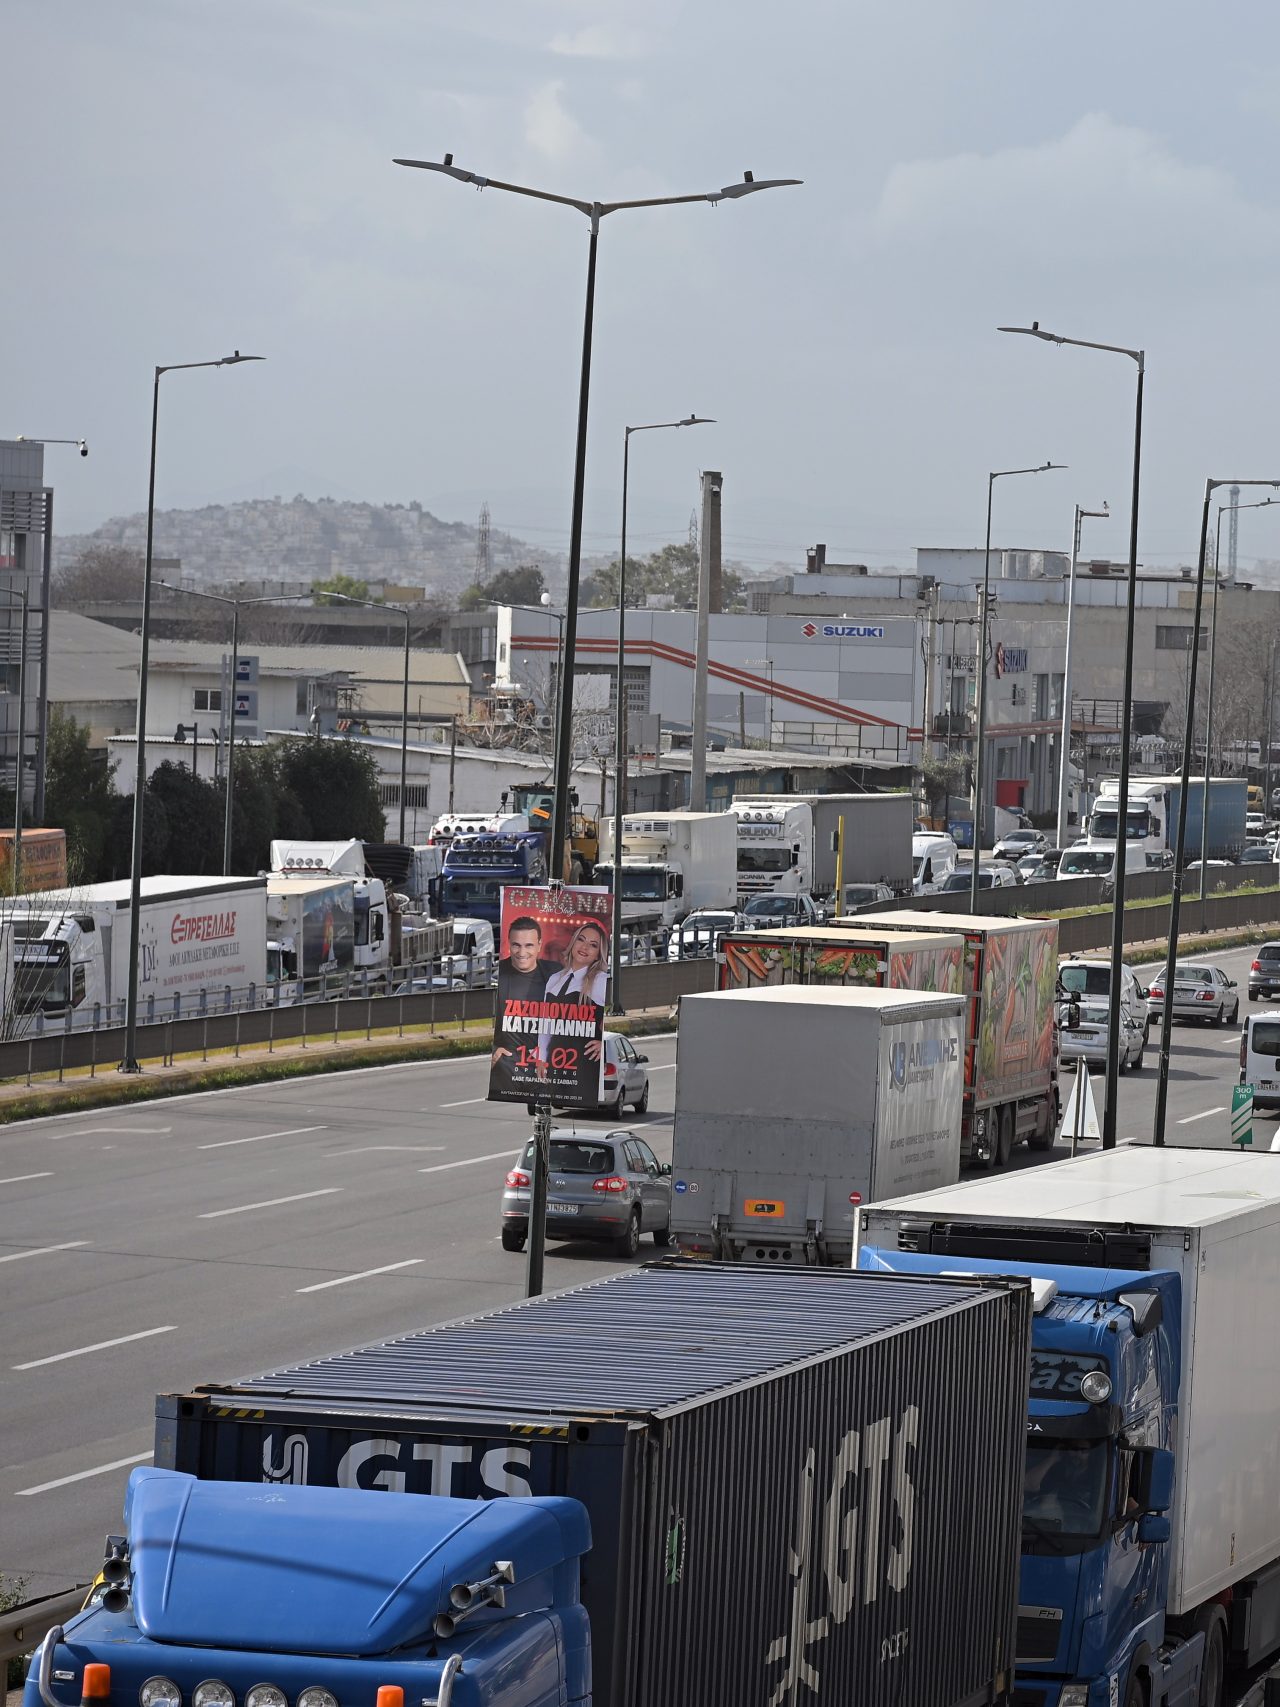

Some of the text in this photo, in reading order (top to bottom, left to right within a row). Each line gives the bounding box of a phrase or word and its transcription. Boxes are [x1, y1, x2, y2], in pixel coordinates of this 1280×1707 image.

[823, 625, 884, 638] SUZUKI
[1004, 650, 1028, 673] SUZUKI
[504, 999, 597, 1022] ΖΑΖΟΠΟΥΛΟΣ
[502, 1015, 596, 1038] ΚΑΤΣΙΓΙΑΝΝΗ
[515, 1045, 578, 1070] 14.02
[1029, 1367, 1084, 1393] as
[337, 1438, 533, 1499] GTS
[822, 1403, 919, 1625] GTS
[1038, 1609, 1057, 1618] FH
